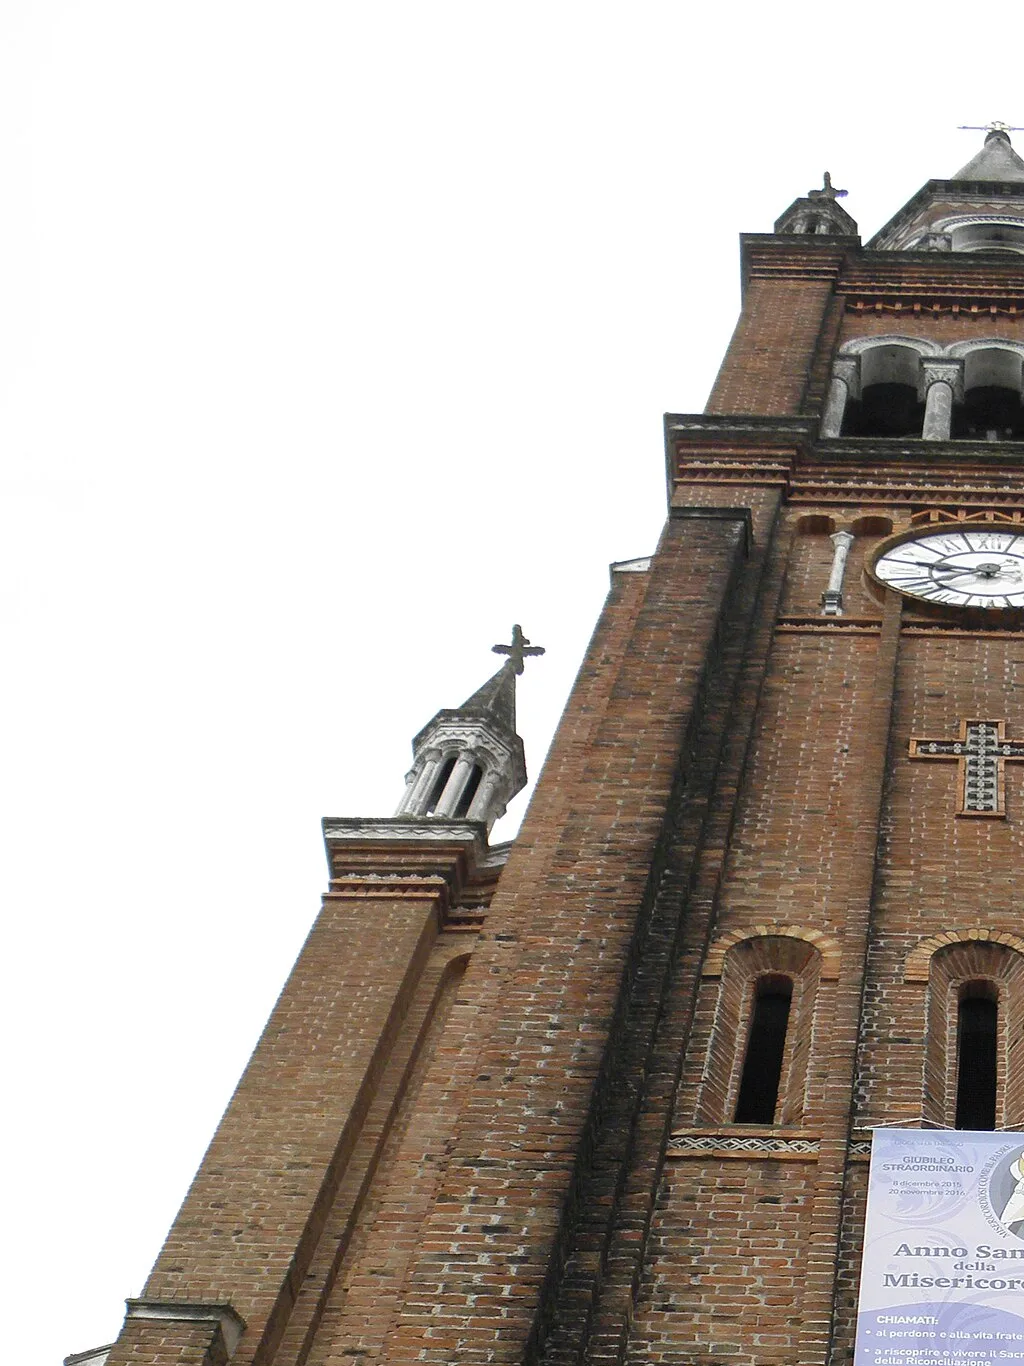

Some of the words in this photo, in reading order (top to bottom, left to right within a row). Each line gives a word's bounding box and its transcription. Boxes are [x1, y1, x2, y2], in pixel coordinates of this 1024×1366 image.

[978, 536, 1002, 550] XII
[988, 1143, 1014, 1163] PADRE
[902, 1156, 955, 1165] GIUBILEO
[882, 1163, 975, 1173] STRAORDINARIO
[899, 1180, 940, 1188] dicembre
[893, 1243, 968, 1258] Anno
[953, 1261, 996, 1272] della
[876, 1315, 939, 1325] CHIAMATI:
[875, 1329, 886, 1337] al
[889, 1330, 936, 1339] perdono
[949, 1331, 970, 1339] alla
[973, 1331, 993, 1339] vita
[884, 1348, 940, 1358] riscoprire
[942, 1349, 950, 1357] e
[952, 1349, 986, 1358] vivere
[989, 1350, 997, 1358] il
[874, 1357, 903, 1365] della
